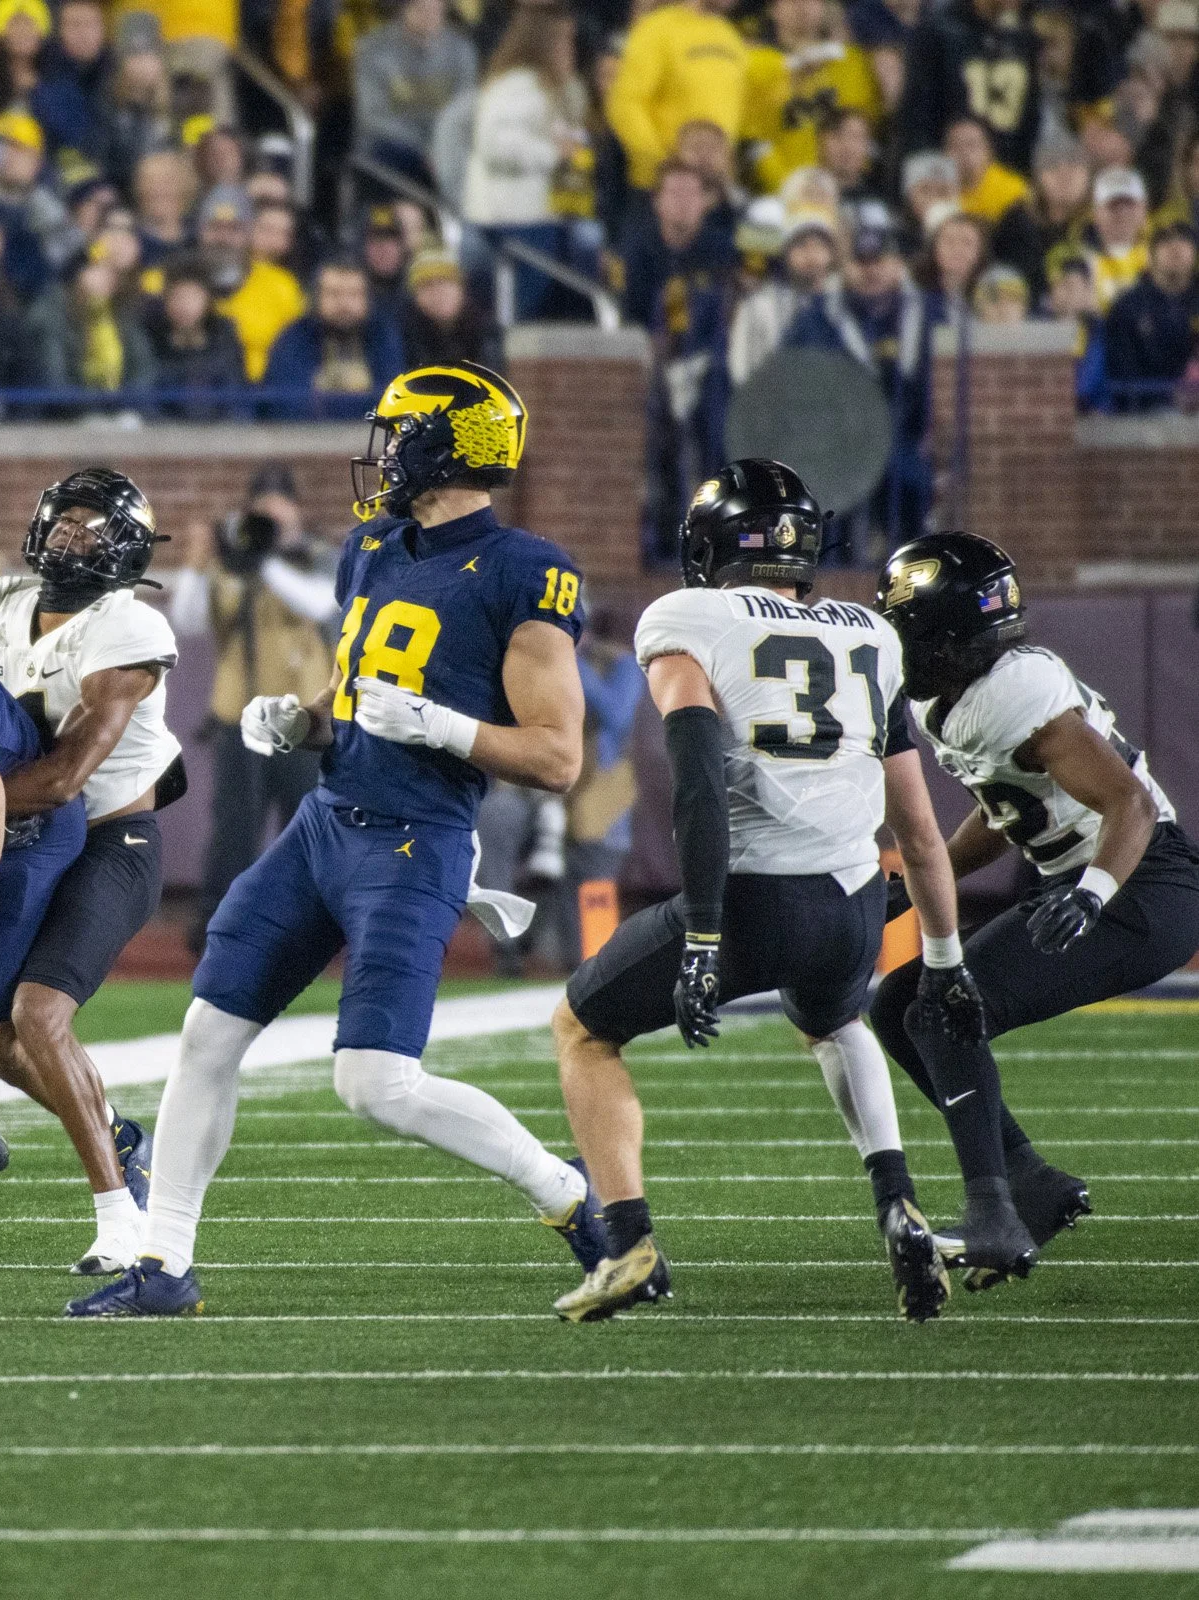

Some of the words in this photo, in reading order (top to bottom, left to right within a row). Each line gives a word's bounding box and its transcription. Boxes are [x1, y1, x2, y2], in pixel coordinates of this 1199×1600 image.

[538, 567, 579, 617] 18
[886, 558, 942, 609] P
[735, 593, 875, 630] THIENEMAN
[333, 596, 442, 721] 18
[749, 633, 886, 763] 31
